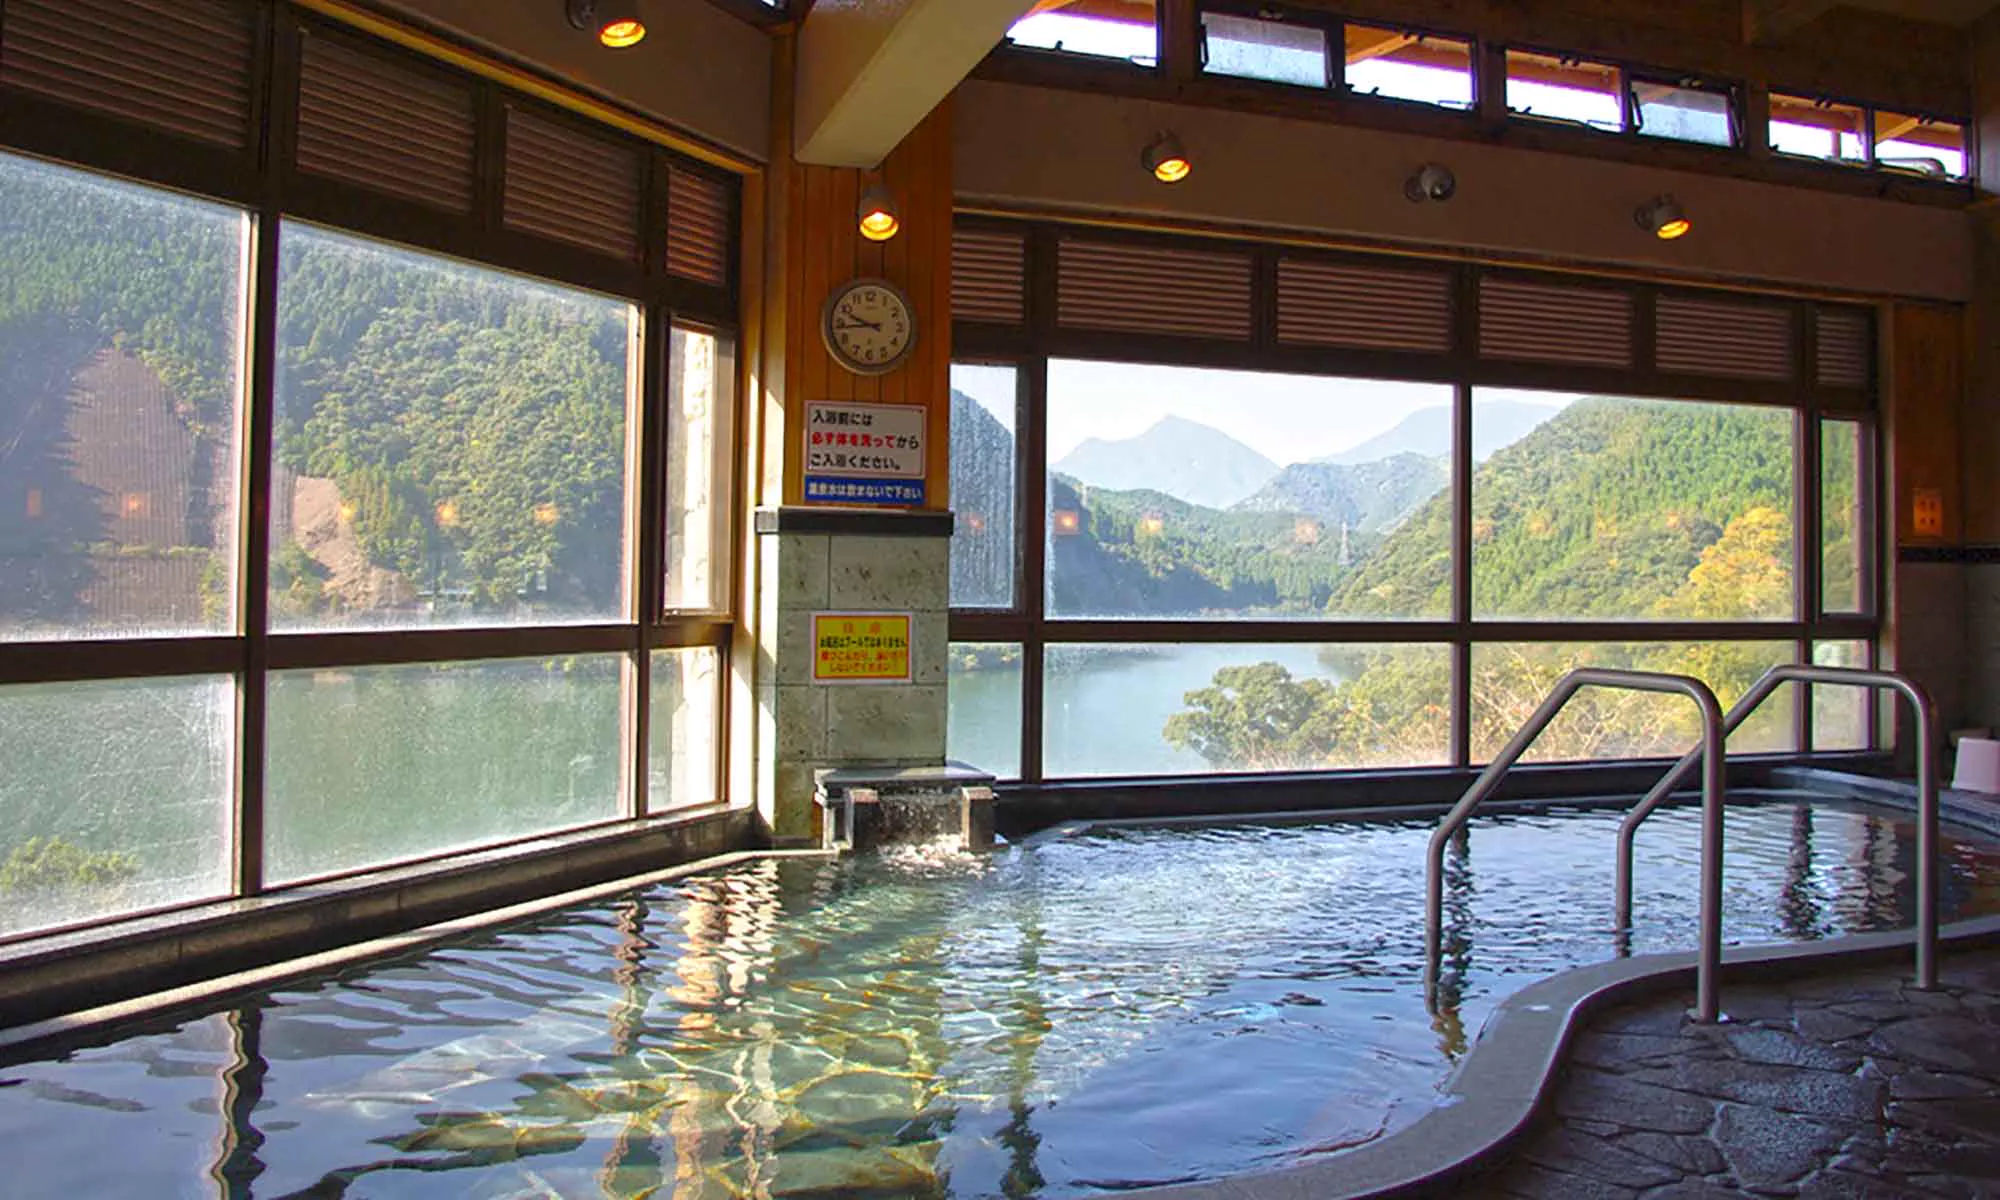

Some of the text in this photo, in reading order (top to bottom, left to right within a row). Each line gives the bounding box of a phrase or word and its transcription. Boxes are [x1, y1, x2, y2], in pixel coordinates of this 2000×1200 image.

[852, 294, 861, 304] 11
[864, 291, 877, 302] 12
[841, 304, 852, 314] 10
[891, 306, 900, 318] 2
[891, 336, 898, 346] 4
[852, 344, 860, 355] 7
[865, 349, 873, 360] 6
[812, 409, 873, 426] 入浴前には
